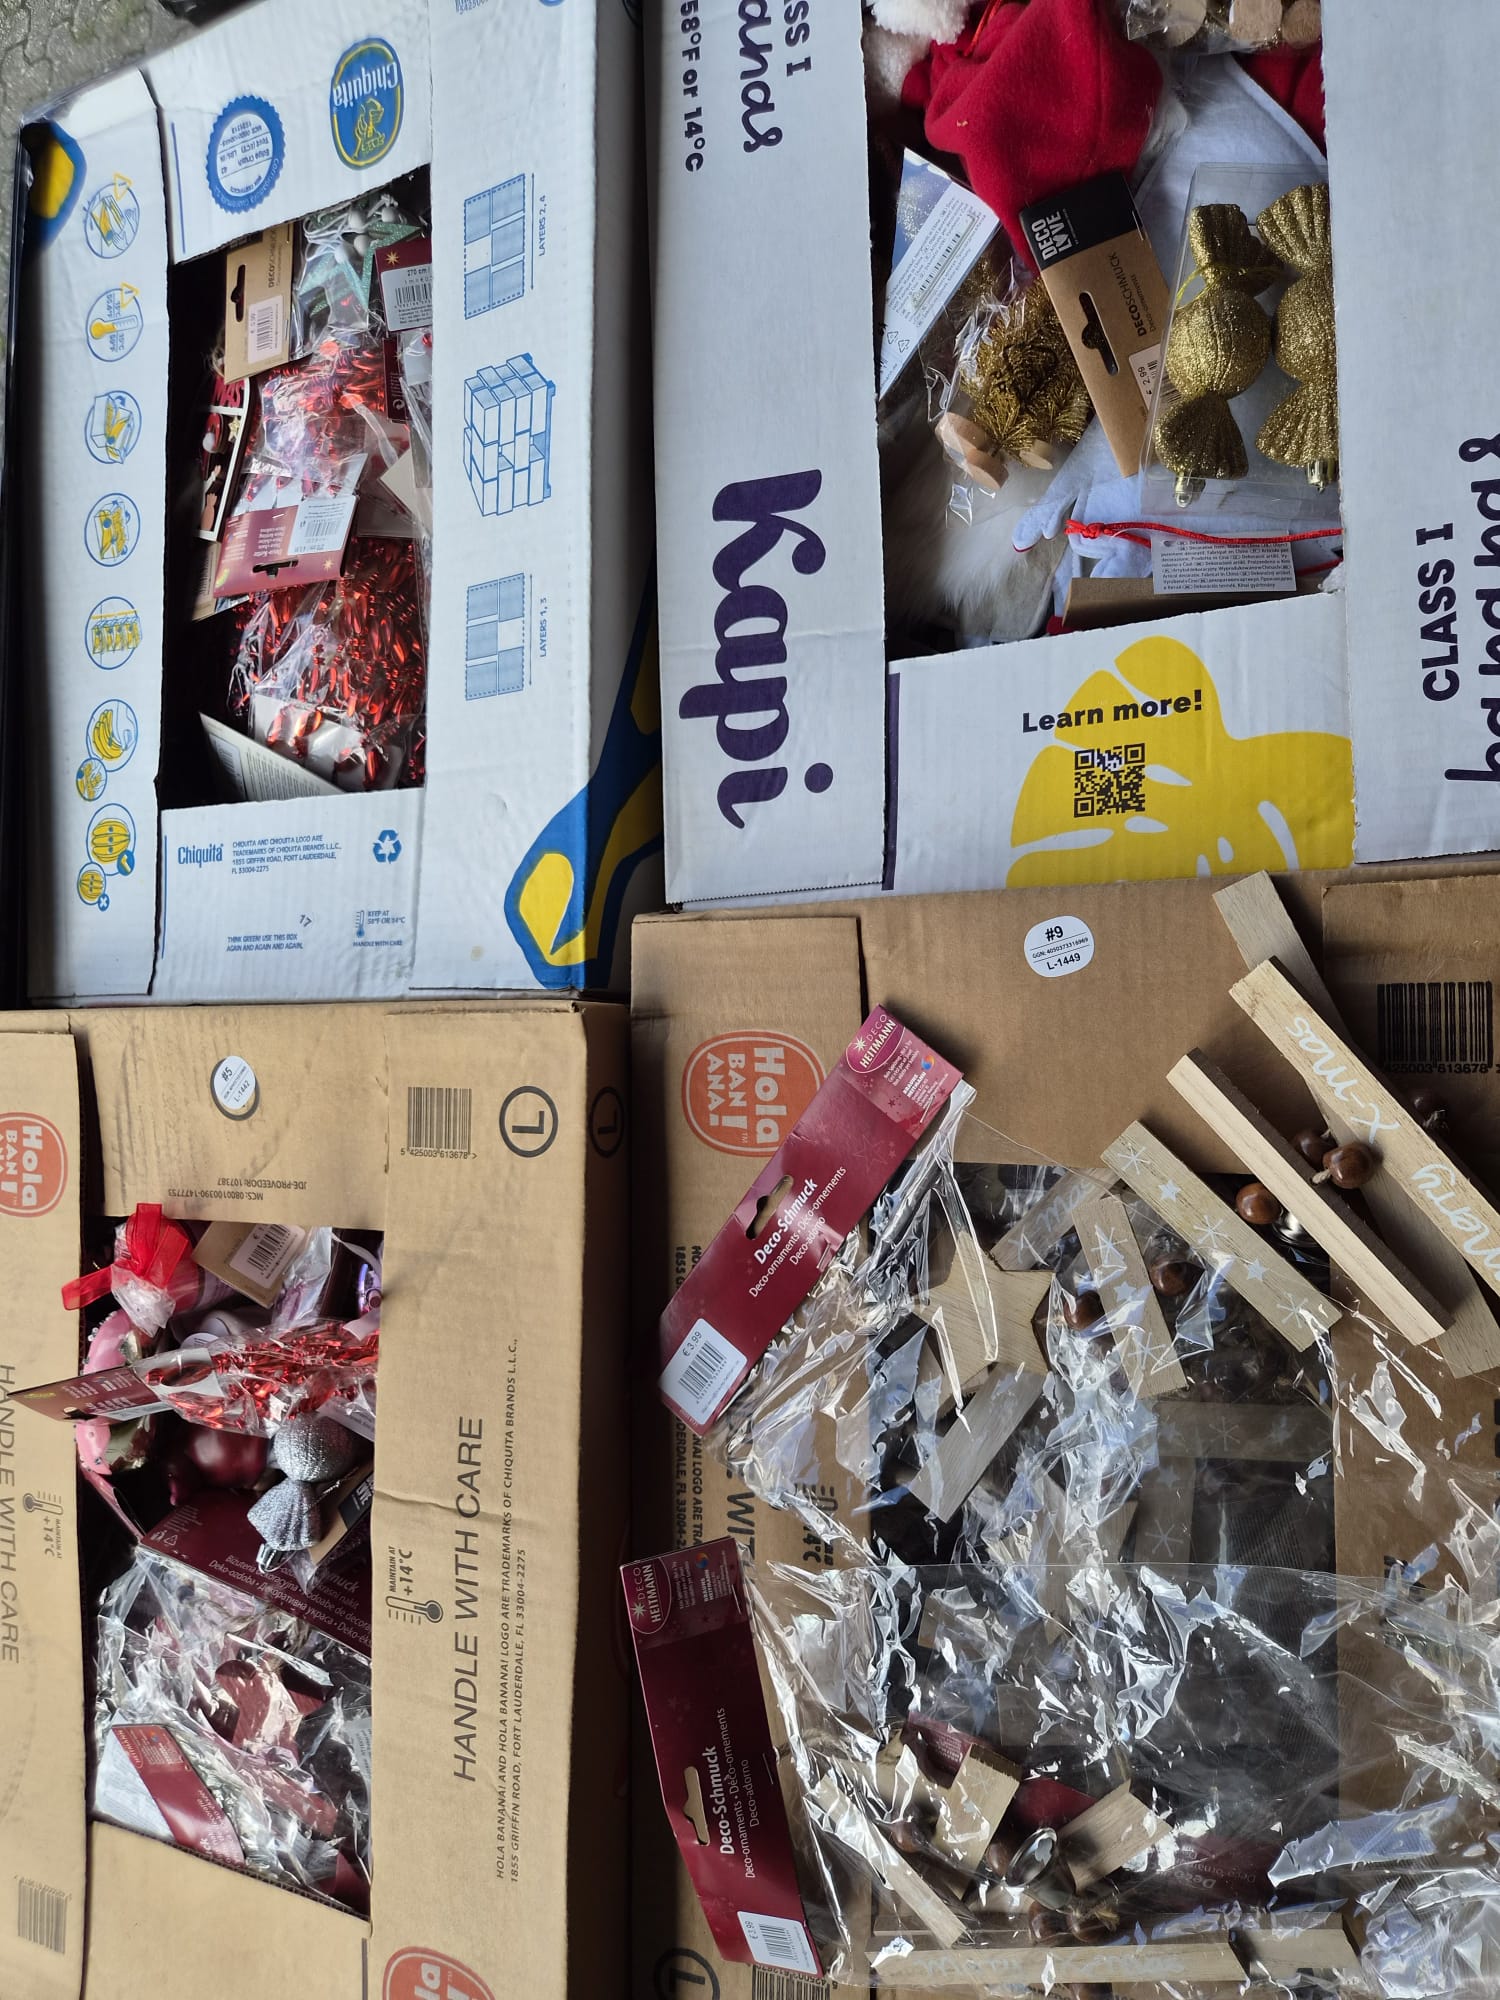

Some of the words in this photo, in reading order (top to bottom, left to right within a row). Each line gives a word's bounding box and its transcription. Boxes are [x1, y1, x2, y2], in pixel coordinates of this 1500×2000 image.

[333, 61, 398, 108] Chiquita
[683, 70, 698, 97] or
[684, 107, 705, 172] 14°C
[1108, 252, 1147, 337] DECOSCHMUCK
[1417, 558, 1459, 700] CLASS
[679, 470, 834, 829] Kapi
[1023, 708, 1103, 733] Learn
[1114, 690, 1202, 721] more!
[177, 843, 222, 868] Chiquita
[232, 847, 267, 857] TRADEMARKS
[258, 838, 268, 846] AND
[311, 834, 322, 842] ARE
[246, 856, 265, 864] GRIFFIN
[283, 854, 298, 862] FORT
[226, 944, 242, 952] AGAIN
[242, 943, 253, 951] AND
[262, 934, 272, 942] USE
[1045, 925, 1063, 941] #9
[1046, 953, 1080, 969] L-1449
[859, 1018, 896, 1068] HEITMANN
[865, 1013, 887, 1042] DECO
[221, 1066, 232, 1081] #5
[728, 1053, 747, 1107] BAN
[902, 1073, 918, 1094] BRAUNS
[906, 1071, 926, 1097] HEITMANN
[1437, 1063, 1488, 1072] 613678
[754, 1047, 787, 1144] Hola
[6, 1129, 17, 1174] BAN
[22, 1125, 42, 1206] Hola
[439, 1150, 468, 1159] 613678
[217, 1177, 241, 1185] 107387
[245, 1191, 263, 1199] MCS:
[753, 1178, 818, 1266] Deco-Schmuck
[788, 1213, 827, 1266] Deco-adorno
[748, 1229, 799, 1299] Deco-ornaments
[505, 1376, 516, 1425] BRANDS
[455, 1415, 482, 1518] CARE
[503, 1430, 514, 1487] CHIQUITA
[692, 1462, 703, 1495] LOGO
[503, 1491, 512, 1507] OF
[692, 1497, 703, 1520] ARE
[0, 1496, 17, 1571] WITH
[388, 1545, 395, 1555] AT
[501, 1511, 512, 1592] TRADEMARKS
[388, 1557, 397, 1591] MAINTAIN
[398, 1548, 413, 1595] +14°C
[455, 1529, 479, 1620] WITH
[516, 1548, 526, 1618] 33004-2275
[633, 1567, 645, 1599] DECO
[501, 1595, 510, 1619] ARE
[643, 1564, 661, 1622] HEITMANN
[0, 1581, 19, 1663] CARE
[500, 1622, 509, 1656] LOGO
[514, 1622, 524, 1635] FL
[513, 1640, 524, 1722] LAUDERDALE,
[453, 1630, 478, 1782] HANDLE
[498, 1718, 508, 1751] HOLA
[512, 1725, 522, 1757] FORT
[497, 1755, 507, 1782] AND
[511, 1761, 522, 1798] ROAD,
[702, 1745, 735, 1855] Deco-Schmuck
[741, 1759, 760, 1832] Deco-adorno
[510, 1802, 520, 1850] GRIFFIN
[734, 1801, 755, 1877] Deco-ornaments
[496, 1845, 504, 1878] HOLA
[510, 1853, 519, 1882] 1855
